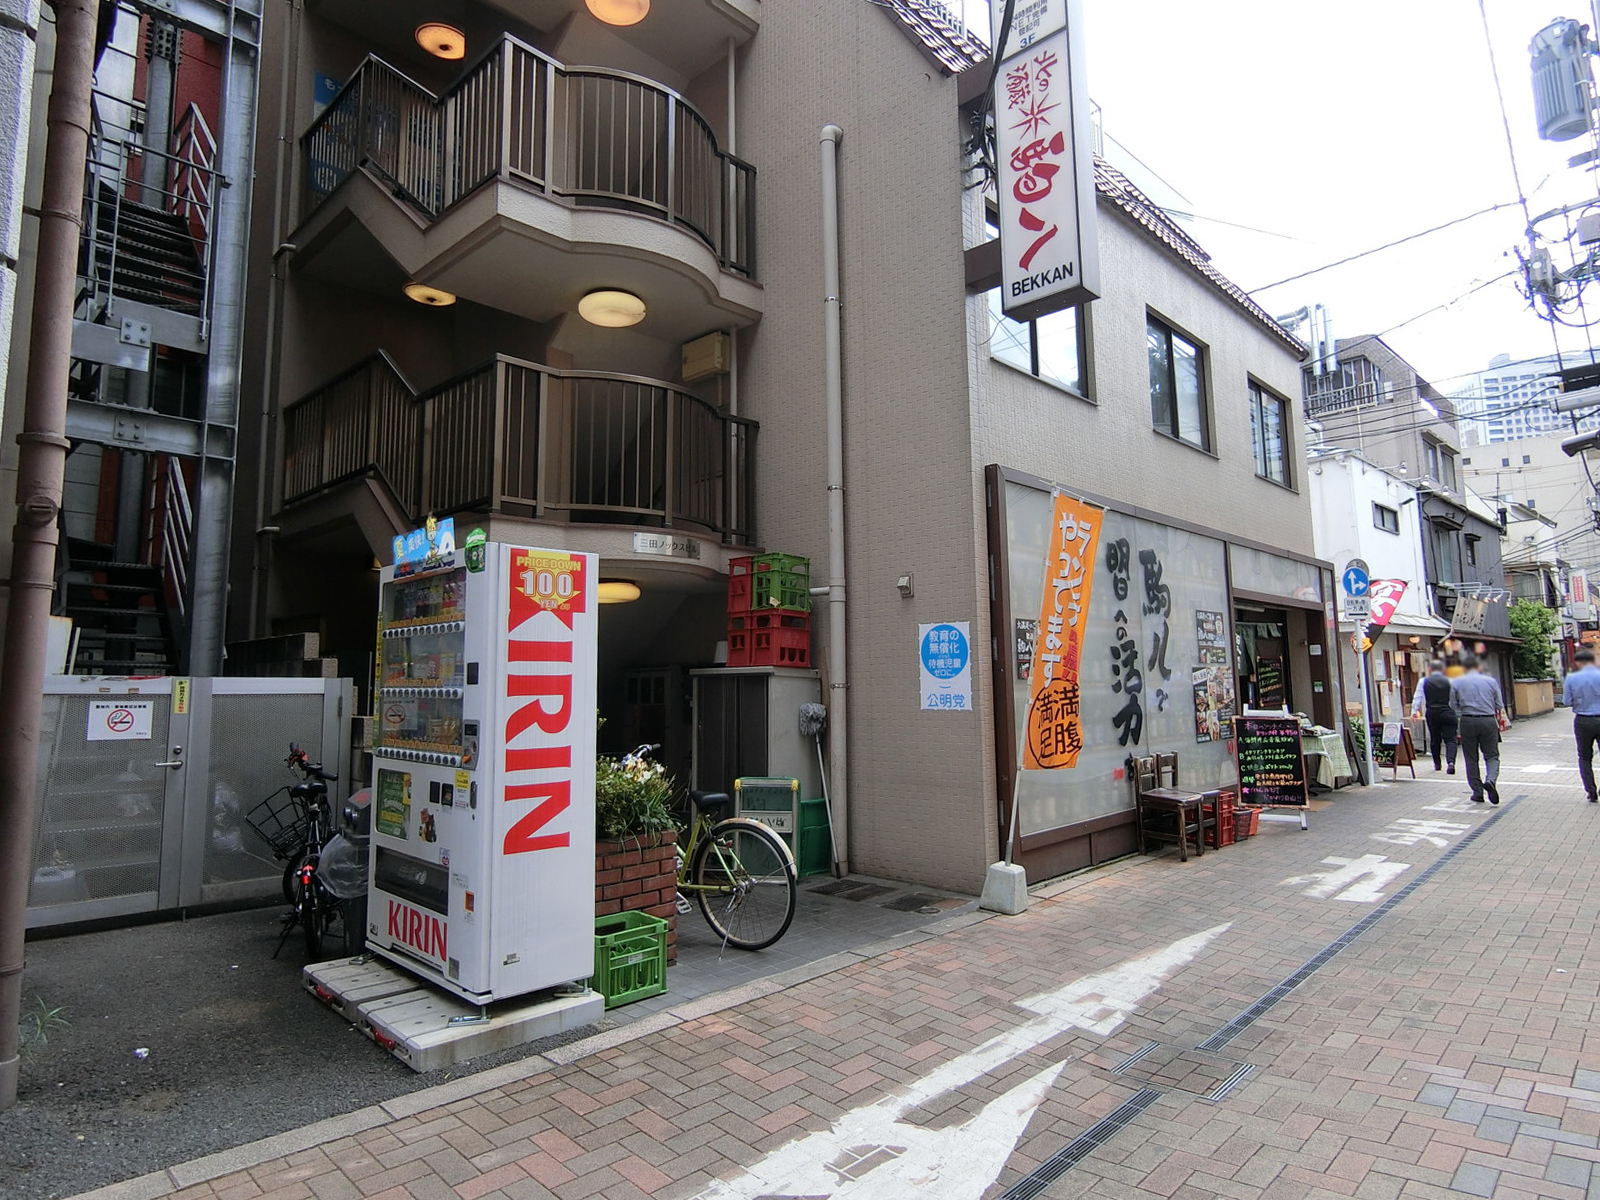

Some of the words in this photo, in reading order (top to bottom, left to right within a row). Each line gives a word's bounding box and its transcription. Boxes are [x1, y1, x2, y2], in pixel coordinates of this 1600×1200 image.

[1020, 32, 1036, 49] 3F
[1011, 262, 1074, 298] BEKKAN
[516, 556, 548, 569] PRICE
[550, 558, 582, 572] DOWN
[1067, 519, 1093, 628] ランチ
[519, 568, 574, 599] 100
[539, 599, 559, 609] YEN
[1040, 511, 1079, 689] やってます
[929, 629, 960, 643] 教育の
[929, 642, 960, 654] 無償化
[1106, 537, 1144, 747] 明日への活力
[928, 658, 962, 668] 待機児童
[927, 693, 965, 708] 公明党
[1036, 690, 1055, 760] 満足
[1054, 684, 1083, 757] 満腹
[388, 899, 448, 962] KIRIN
